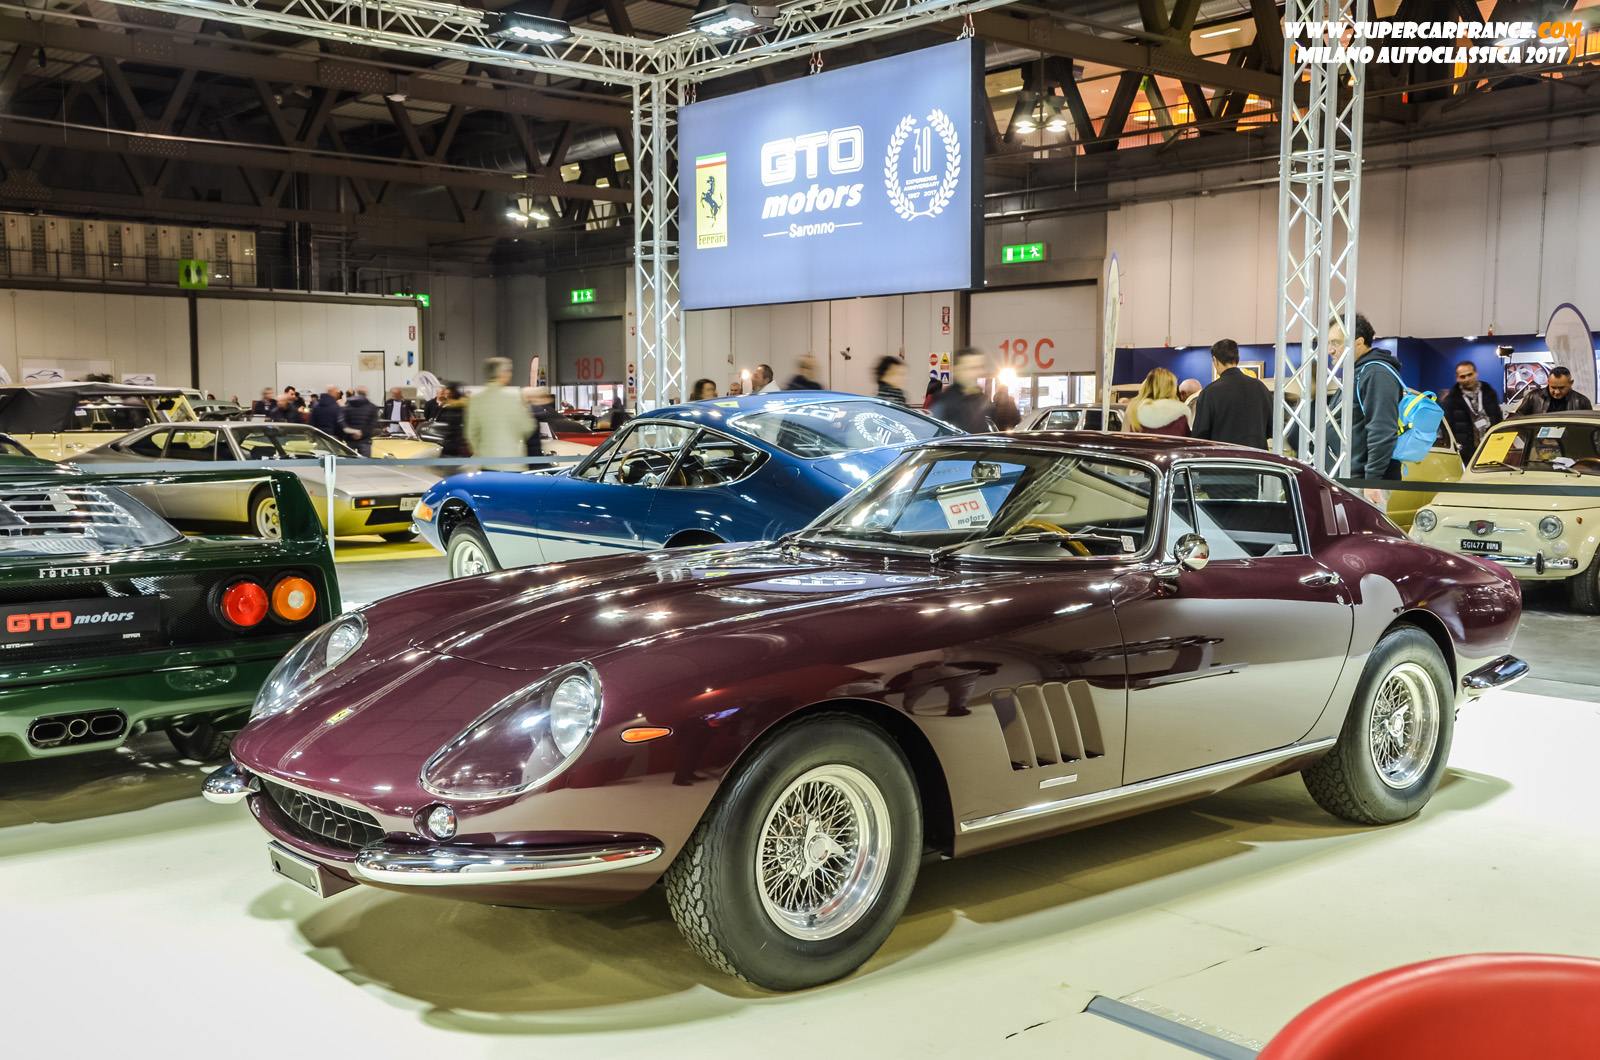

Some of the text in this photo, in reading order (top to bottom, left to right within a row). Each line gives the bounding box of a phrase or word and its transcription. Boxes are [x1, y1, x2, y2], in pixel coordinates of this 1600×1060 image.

[761, 125, 864, 187] GTO
[912, 126, 931, 175] 30
[761, 183, 865, 220] motors
[698, 233, 726, 245] Ferrari
[789, 222, 835, 238] Saronno
[998, 337, 1055, 370] 18 C
[574, 357, 604, 380] 18 D
[949, 500, 980, 515] GTO
[957, 514, 985, 525] motors
[7, 611, 135, 633] GTO motors
